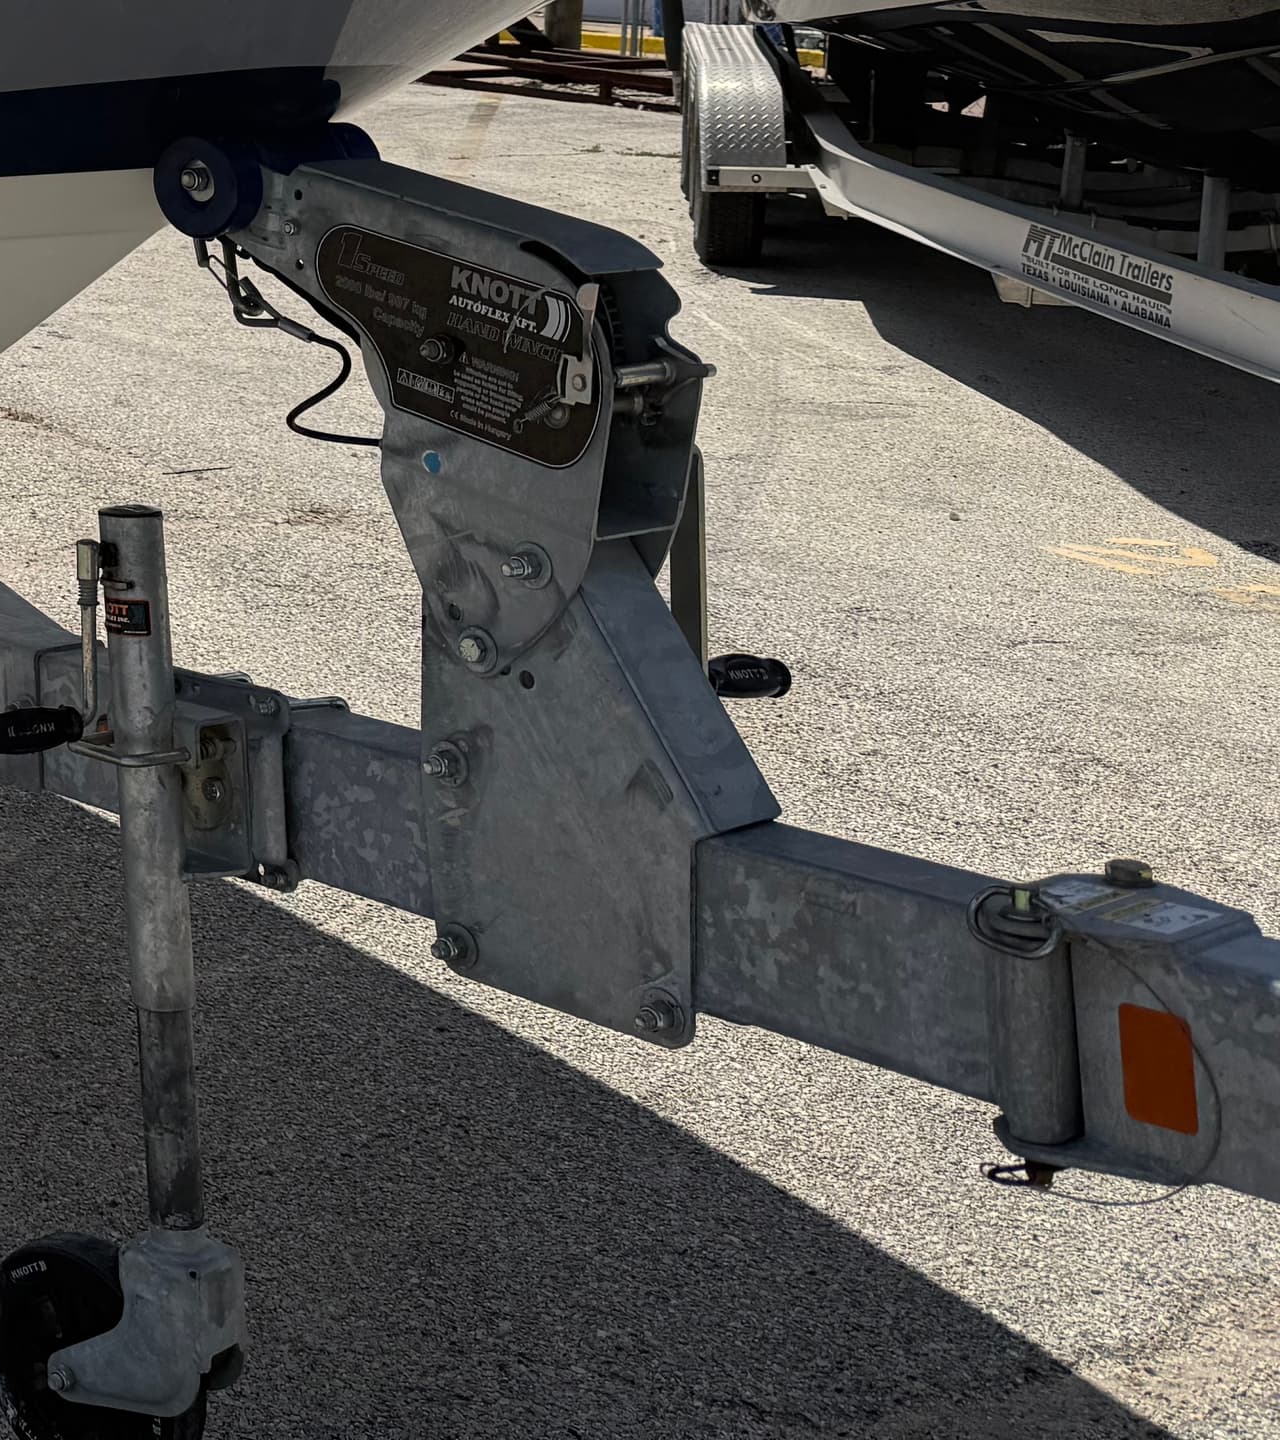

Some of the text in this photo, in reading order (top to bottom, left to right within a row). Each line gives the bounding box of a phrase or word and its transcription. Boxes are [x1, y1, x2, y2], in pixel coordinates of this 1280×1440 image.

[1051, 262, 1073, 277] FOR
[1073, 270, 1090, 285] THE
[1093, 278, 1129, 299] LONG
[1056, 234, 1116, 276] McClain
[1118, 253, 1175, 292] Trailers
[448, 294, 511, 324] AUTÓFLEX
[450, 264, 542, 315] KNOTT
[1022, 262, 1171, 329] TEXAS LOUISIANA ALABAMA
